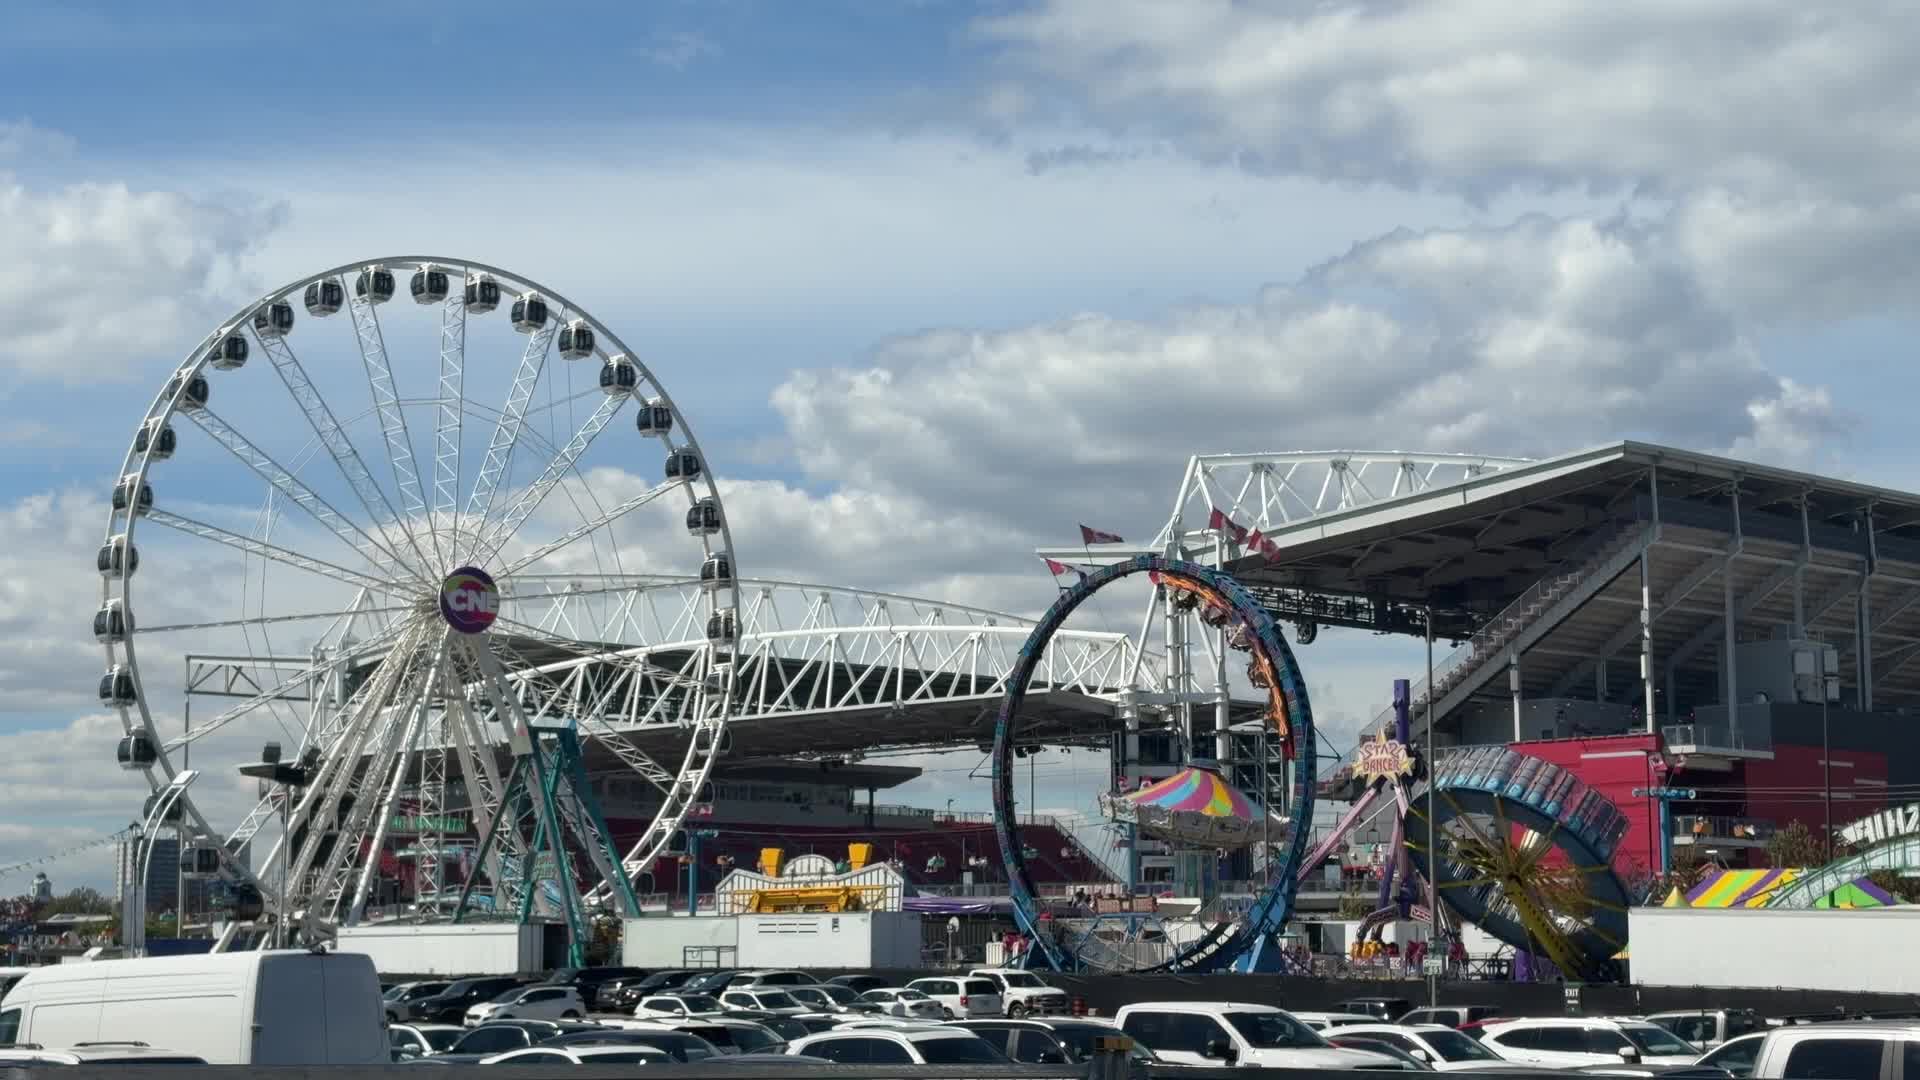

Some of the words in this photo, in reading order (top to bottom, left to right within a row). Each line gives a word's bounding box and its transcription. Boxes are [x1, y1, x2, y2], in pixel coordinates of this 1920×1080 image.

[447, 588, 499, 612] CNE
[1360, 742, 1403, 760] STAR
[1363, 758, 1400, 773] DANCER
[1565, 988, 1579, 997] EXIT
